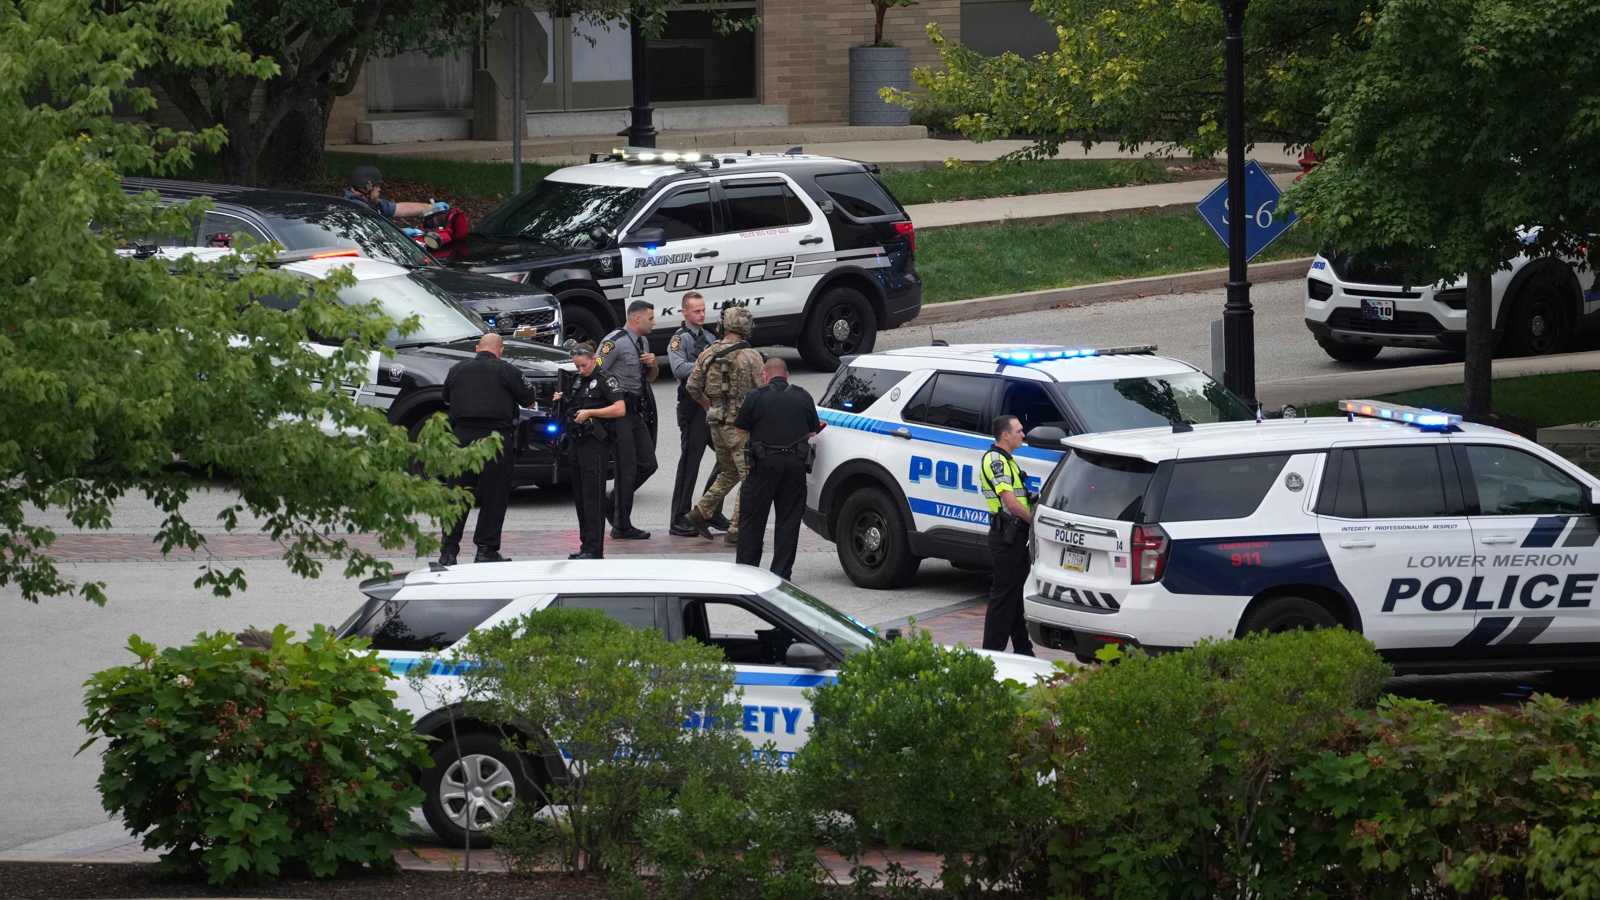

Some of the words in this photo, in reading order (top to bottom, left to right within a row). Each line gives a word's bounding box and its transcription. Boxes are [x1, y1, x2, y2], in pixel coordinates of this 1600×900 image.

[635, 252, 693, 268] RADNOR
[631, 256, 794, 297] POLICE
[908, 455, 1041, 495] POLE
[935, 504, 990, 523] VILLANOVA
[1055, 528, 1085, 546] POLICE
[1231, 552, 1262, 567] 911
[1406, 554, 1487, 569] LOWER
[1493, 553, 1579, 567] MERION
[1381, 573, 1599, 613] POLICE
